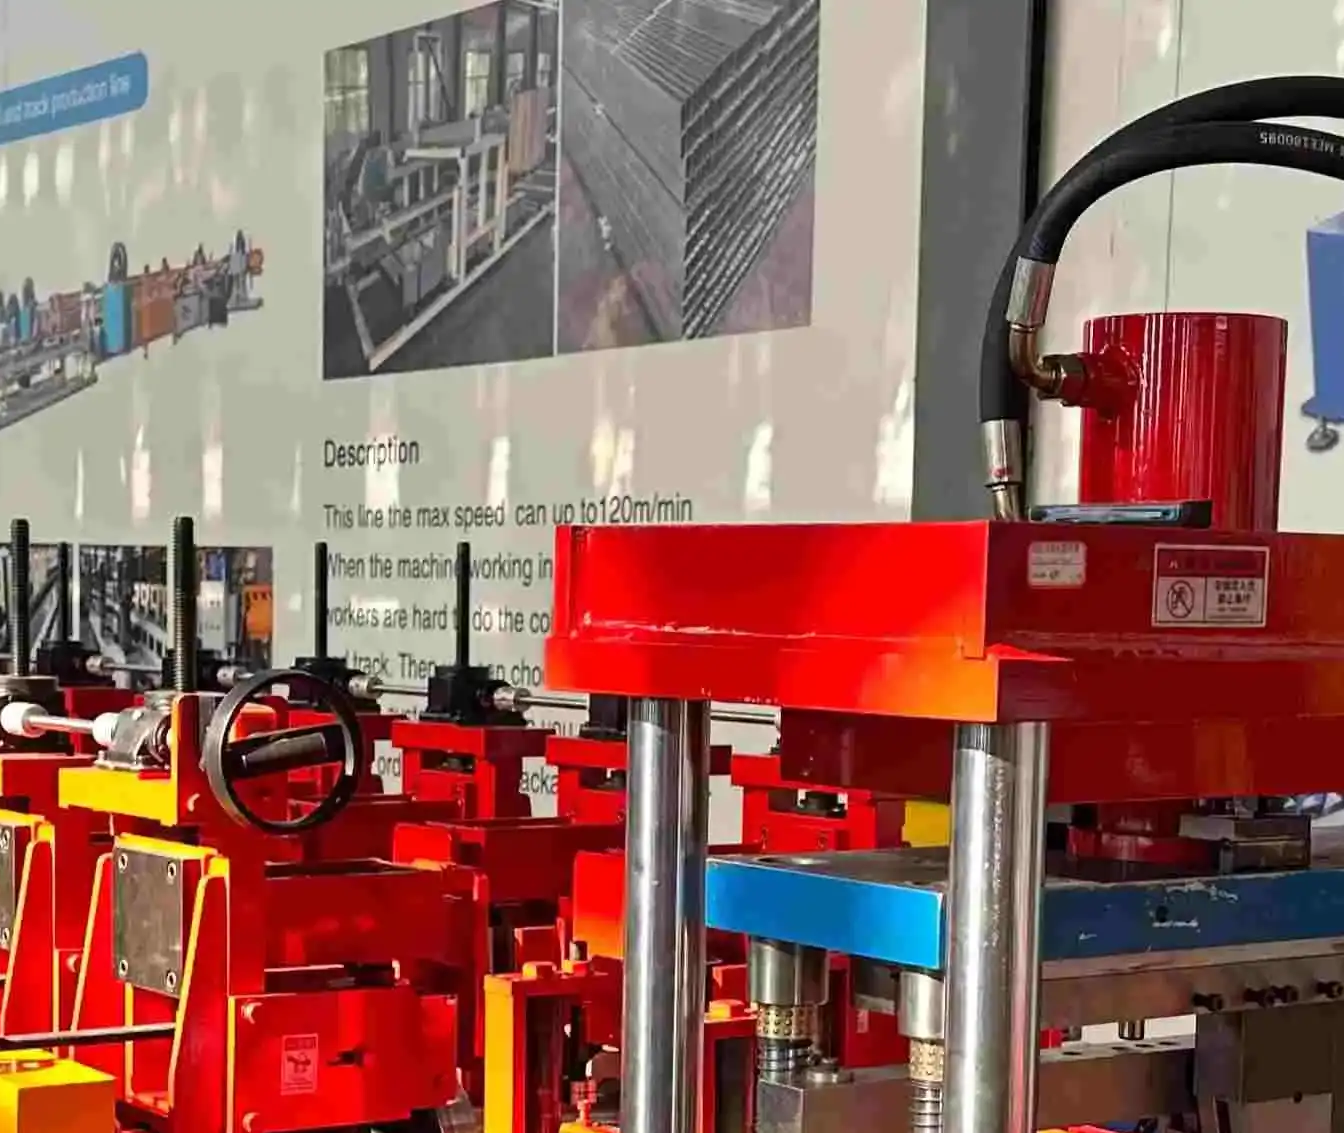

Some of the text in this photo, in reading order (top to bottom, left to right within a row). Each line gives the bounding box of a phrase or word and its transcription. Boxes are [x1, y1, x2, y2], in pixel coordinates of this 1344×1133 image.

[323, 435, 419, 472] Description
[323, 503, 354, 529] This
[358, 503, 383, 529] line
[388, 501, 412, 528] the
[417, 506, 449, 528] max
[455, 498, 505, 533] speed
[516, 503, 546, 527] can
[552, 503, 575, 525] up
[370, 552, 393, 578] the
[469, 552, 533, 588] working
[539, 552, 553, 578] in
[384, 608, 408, 629] are
[413, 603, 447, 630] hard
[472, 605, 493, 632] do
[499, 606, 524, 633] the
[530, 612, 553, 633] co
[510, 657, 546, 687] cho
